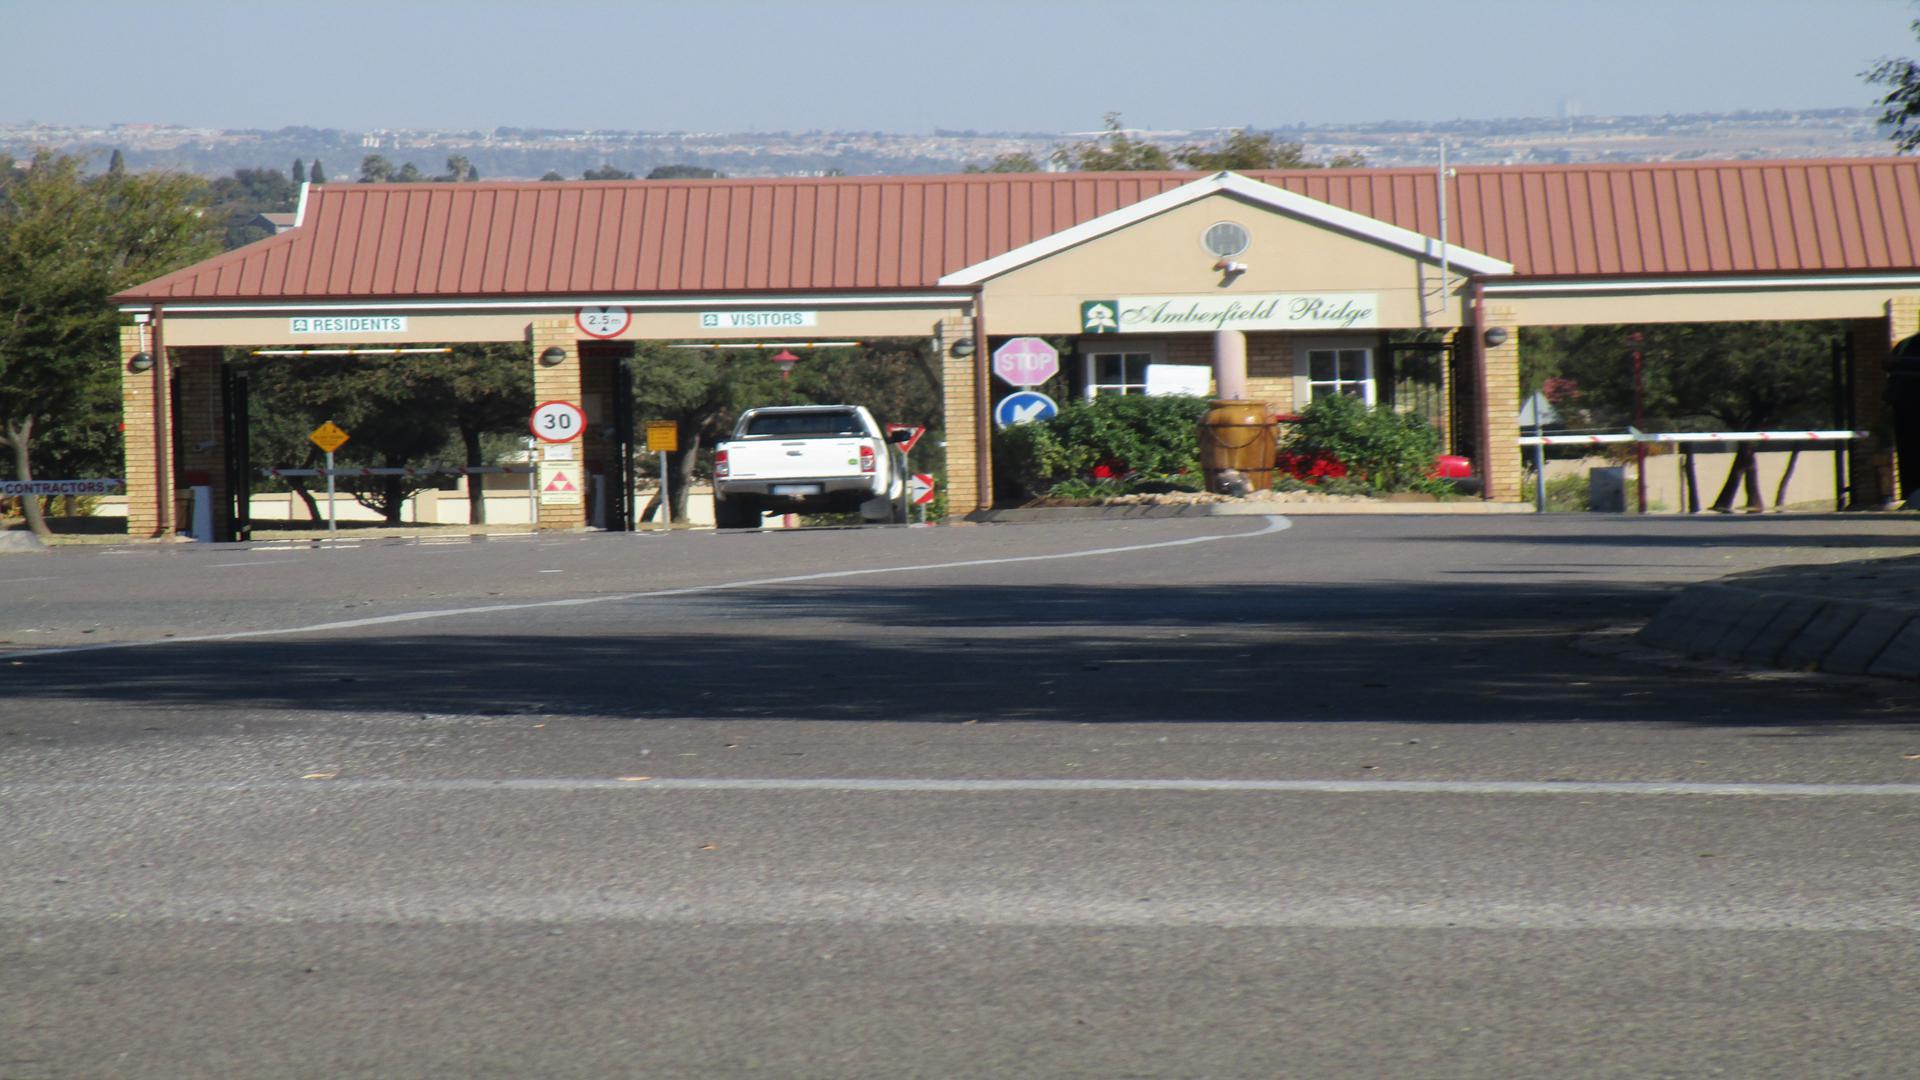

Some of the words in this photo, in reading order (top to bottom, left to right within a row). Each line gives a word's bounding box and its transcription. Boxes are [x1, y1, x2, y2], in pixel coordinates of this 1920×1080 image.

[730, 312, 804, 326] VISITORS
[1119, 298, 1280, 329] Amberfield
[1288, 297, 1372, 327] Ridge
[313, 318, 401, 331] RESIDENTS
[1001, 353, 1053, 371] STOP
[544, 413, 571, 430] 30
[5, 482, 105, 494] CONTRACTORS
